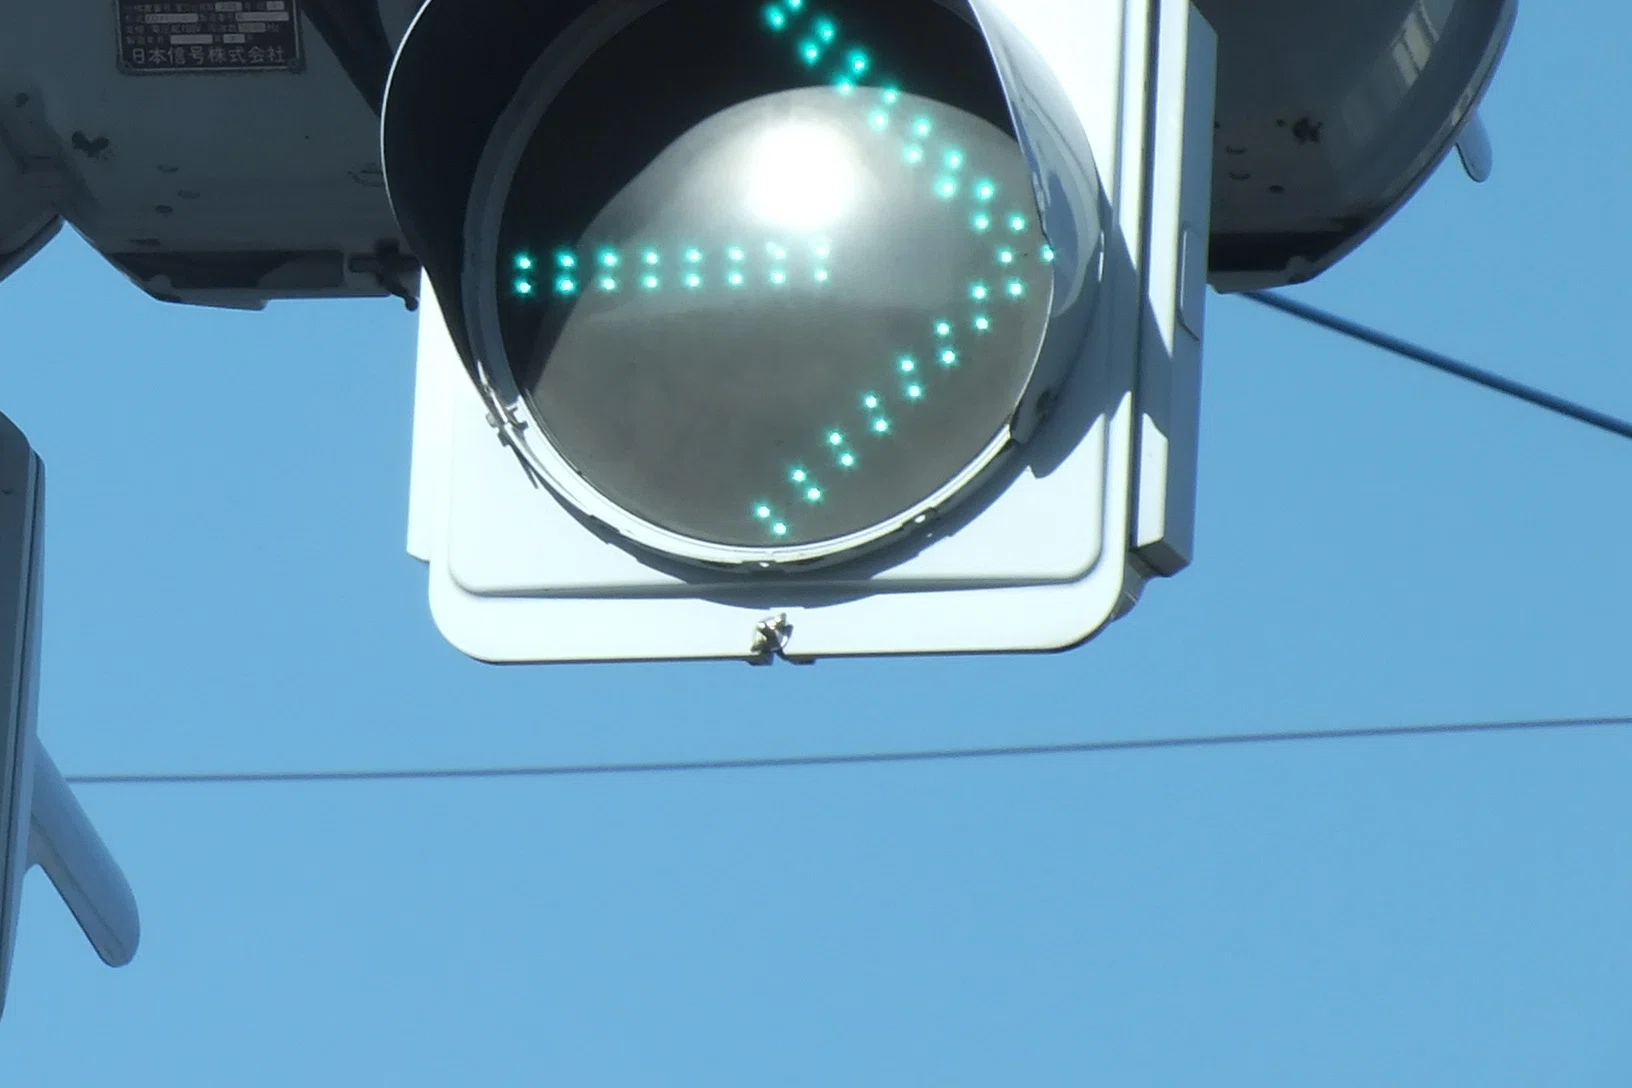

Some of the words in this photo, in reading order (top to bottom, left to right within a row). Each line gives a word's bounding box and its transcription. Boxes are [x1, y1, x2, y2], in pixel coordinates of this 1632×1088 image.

[132, 46, 286, 65] 日本信号株式会社
